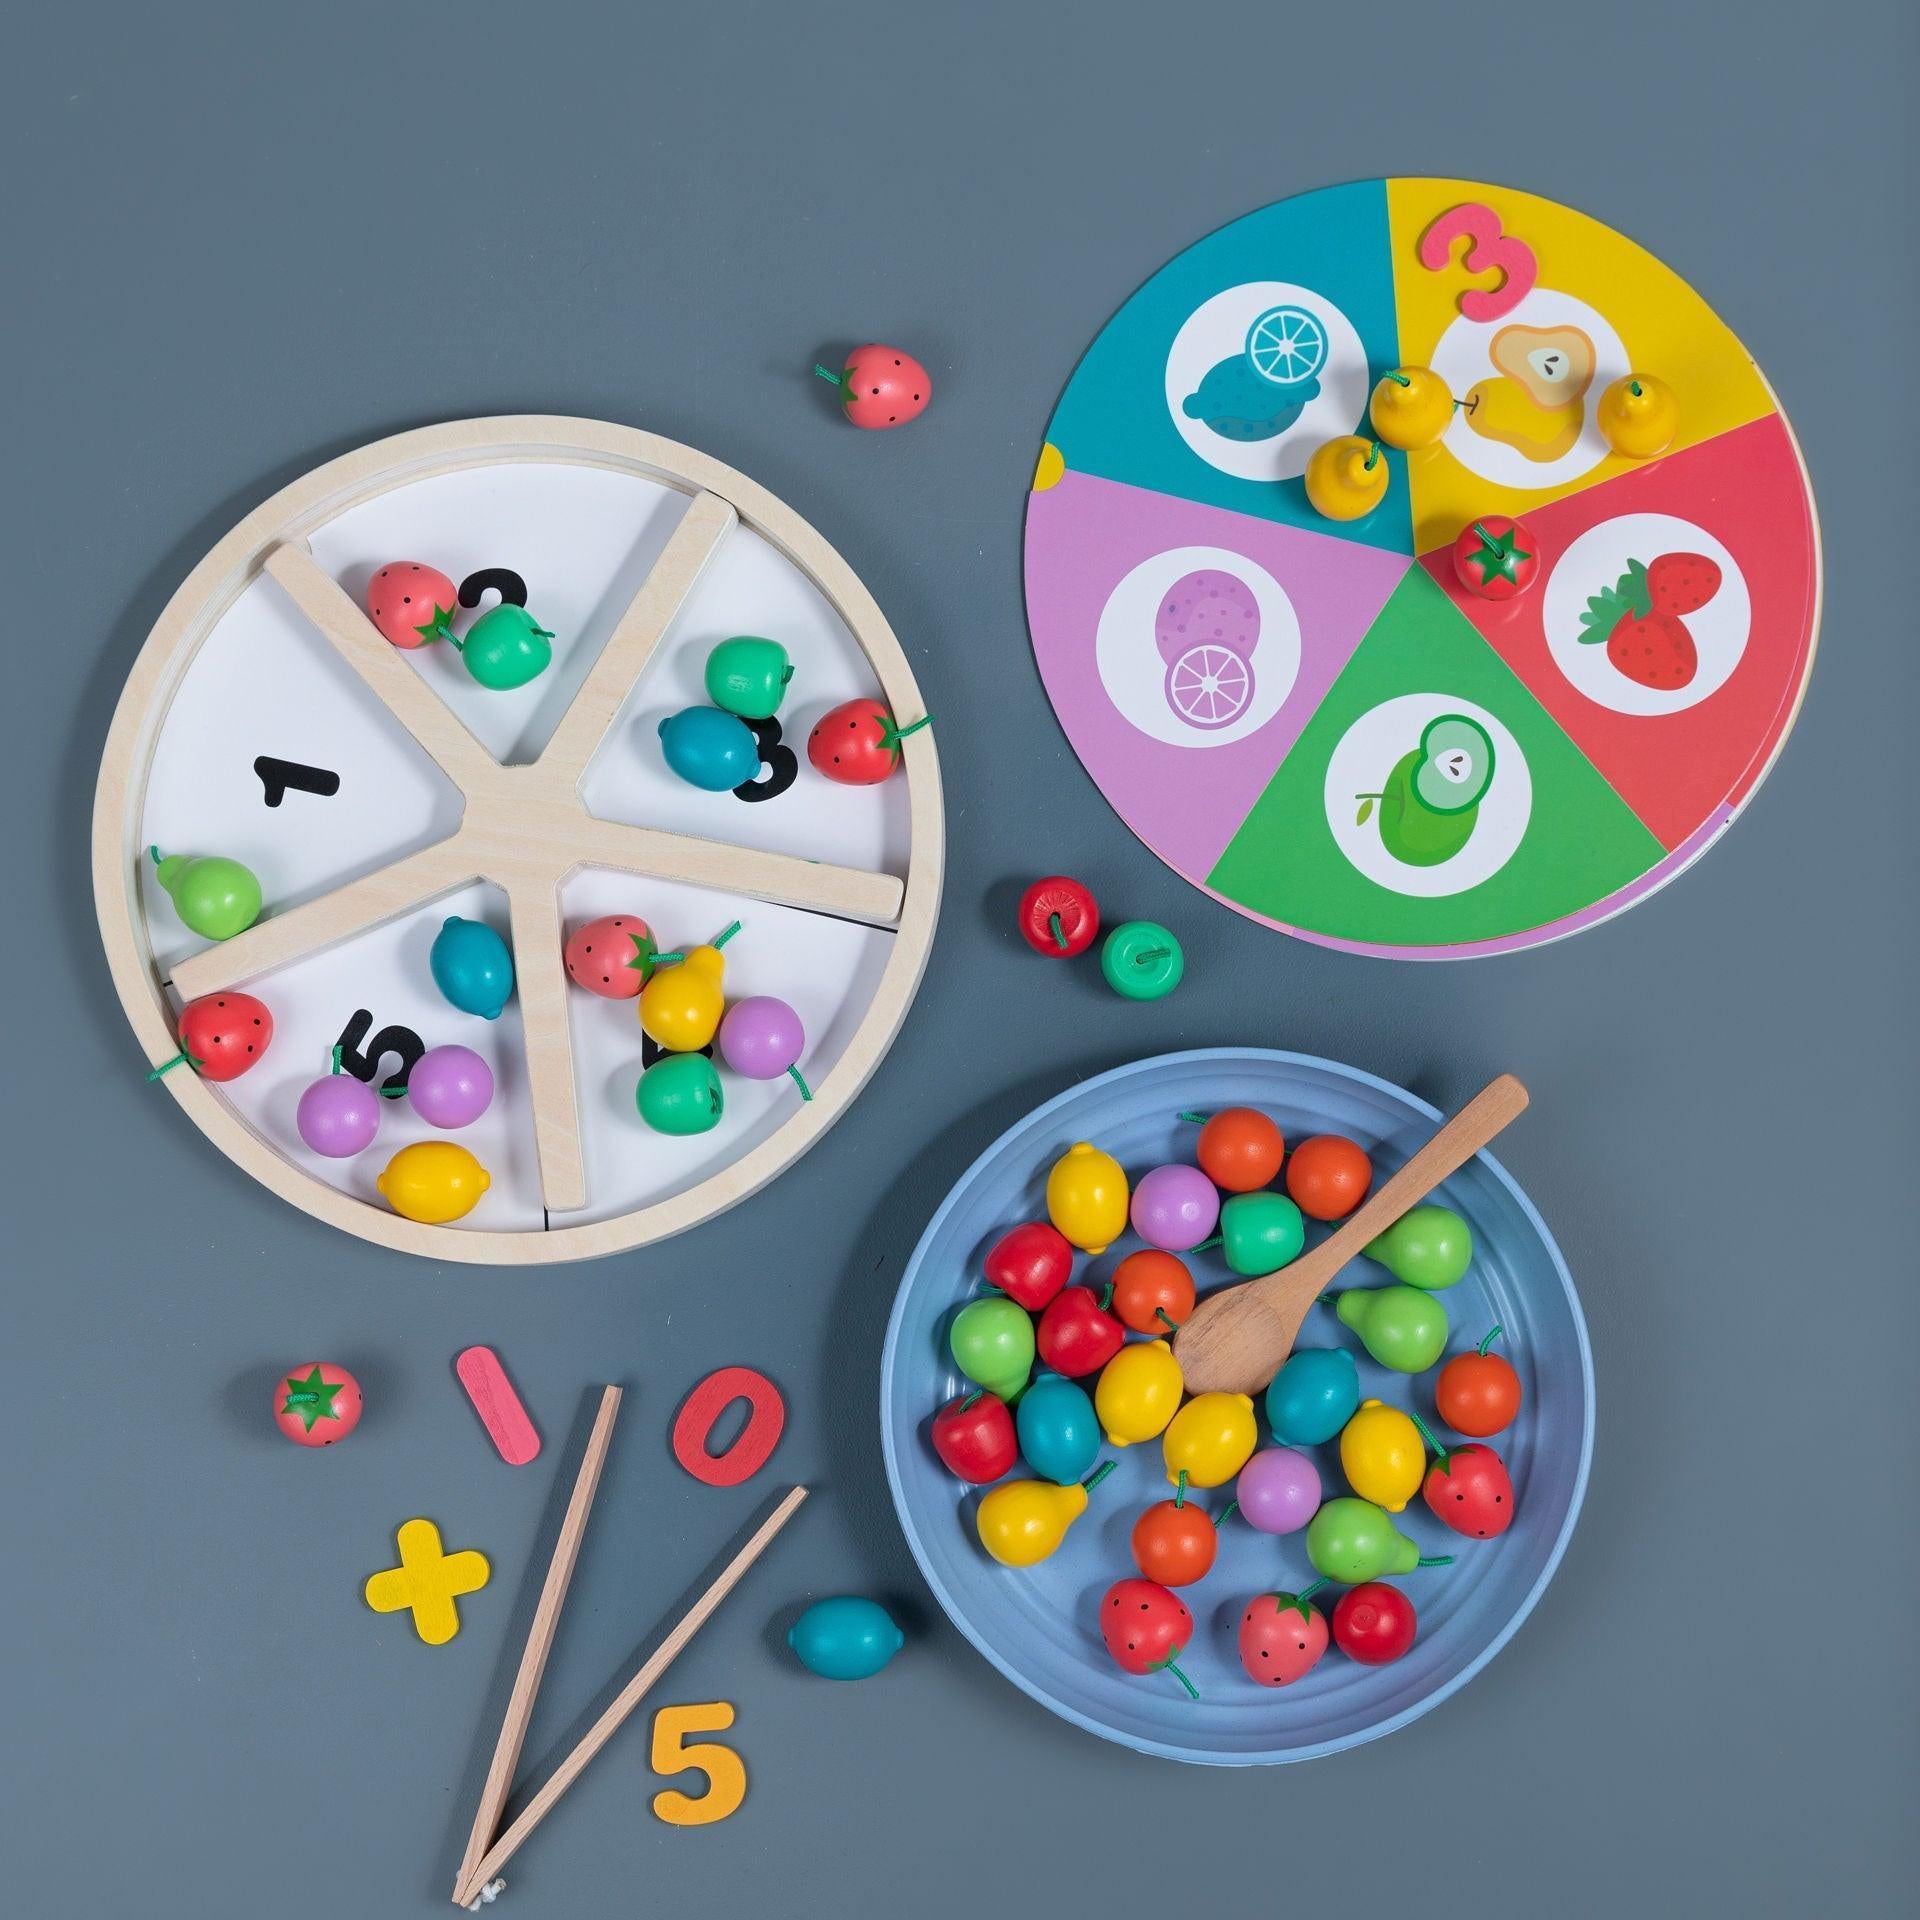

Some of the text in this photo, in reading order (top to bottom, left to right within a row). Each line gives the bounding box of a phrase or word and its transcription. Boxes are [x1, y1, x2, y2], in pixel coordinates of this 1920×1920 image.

[1417, 203, 1537, 323] 3
[253, 755, 341, 808] 1
[332, 1008, 426, 1100] 5
[650, 1701, 748, 1827] 5
